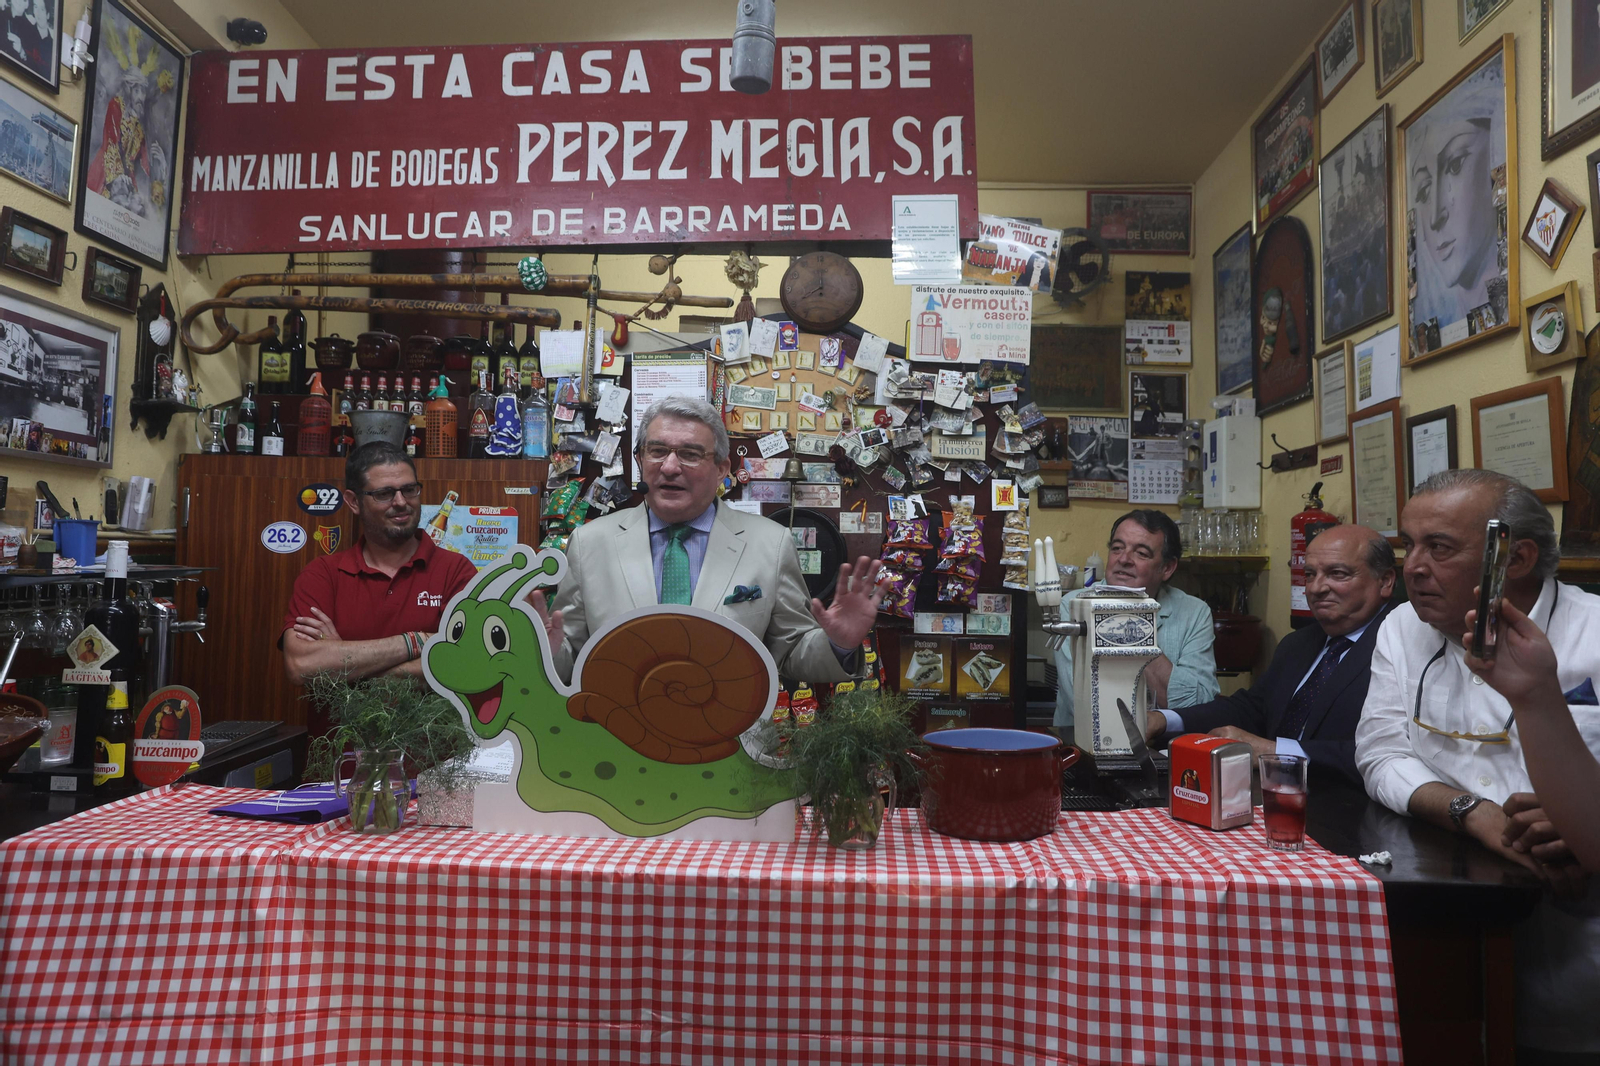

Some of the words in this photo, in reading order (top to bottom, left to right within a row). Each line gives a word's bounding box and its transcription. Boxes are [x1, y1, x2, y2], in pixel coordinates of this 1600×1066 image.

[227, 58, 298, 103] EN
[325, 53, 473, 101] ESTA
[502, 50, 650, 96] CASA
[781, 43, 931, 90] BEBE
[191, 151, 339, 192] MANZANILLA
[351, 150, 381, 188] DE
[391, 146, 499, 188] BODEGAS
[516, 120, 688, 188] PEREZ
[710, 116, 886, 185] MEGIA,
[892, 115, 972, 183] S.A.
[299, 210, 512, 242] SANLUCAR
[532, 208, 583, 236] DE
[603, 203, 851, 234] BARRAMEDA
[1013, 230, 1048, 248] DULCE
[1127, 231, 1141, 240] DE
[1144, 231, 1186, 240] EUROPA
[970, 247, 1027, 274] NARANJA
[947, 286, 956, 294] de
[939, 294, 1029, 312] Vermouth
[984, 312, 1029, 321] casero.
[1006, 321, 1028, 330] sifón
[970, 332, 981, 340] de
[745, 415, 840, 428] MINA
[939, 444, 980, 456] ilusión
[316, 488, 339, 505] '92
[478, 507, 501, 515] PRUEBA
[267, 528, 300, 543] 26.2
[466, 525, 508, 535] Cruzcampo
[914, 641, 938, 649] Patero
[76, 674, 110, 683] GITANA
[931, 707, 966, 717] Salmorejo
[1175, 787, 1206, 802] Cruzcampo
